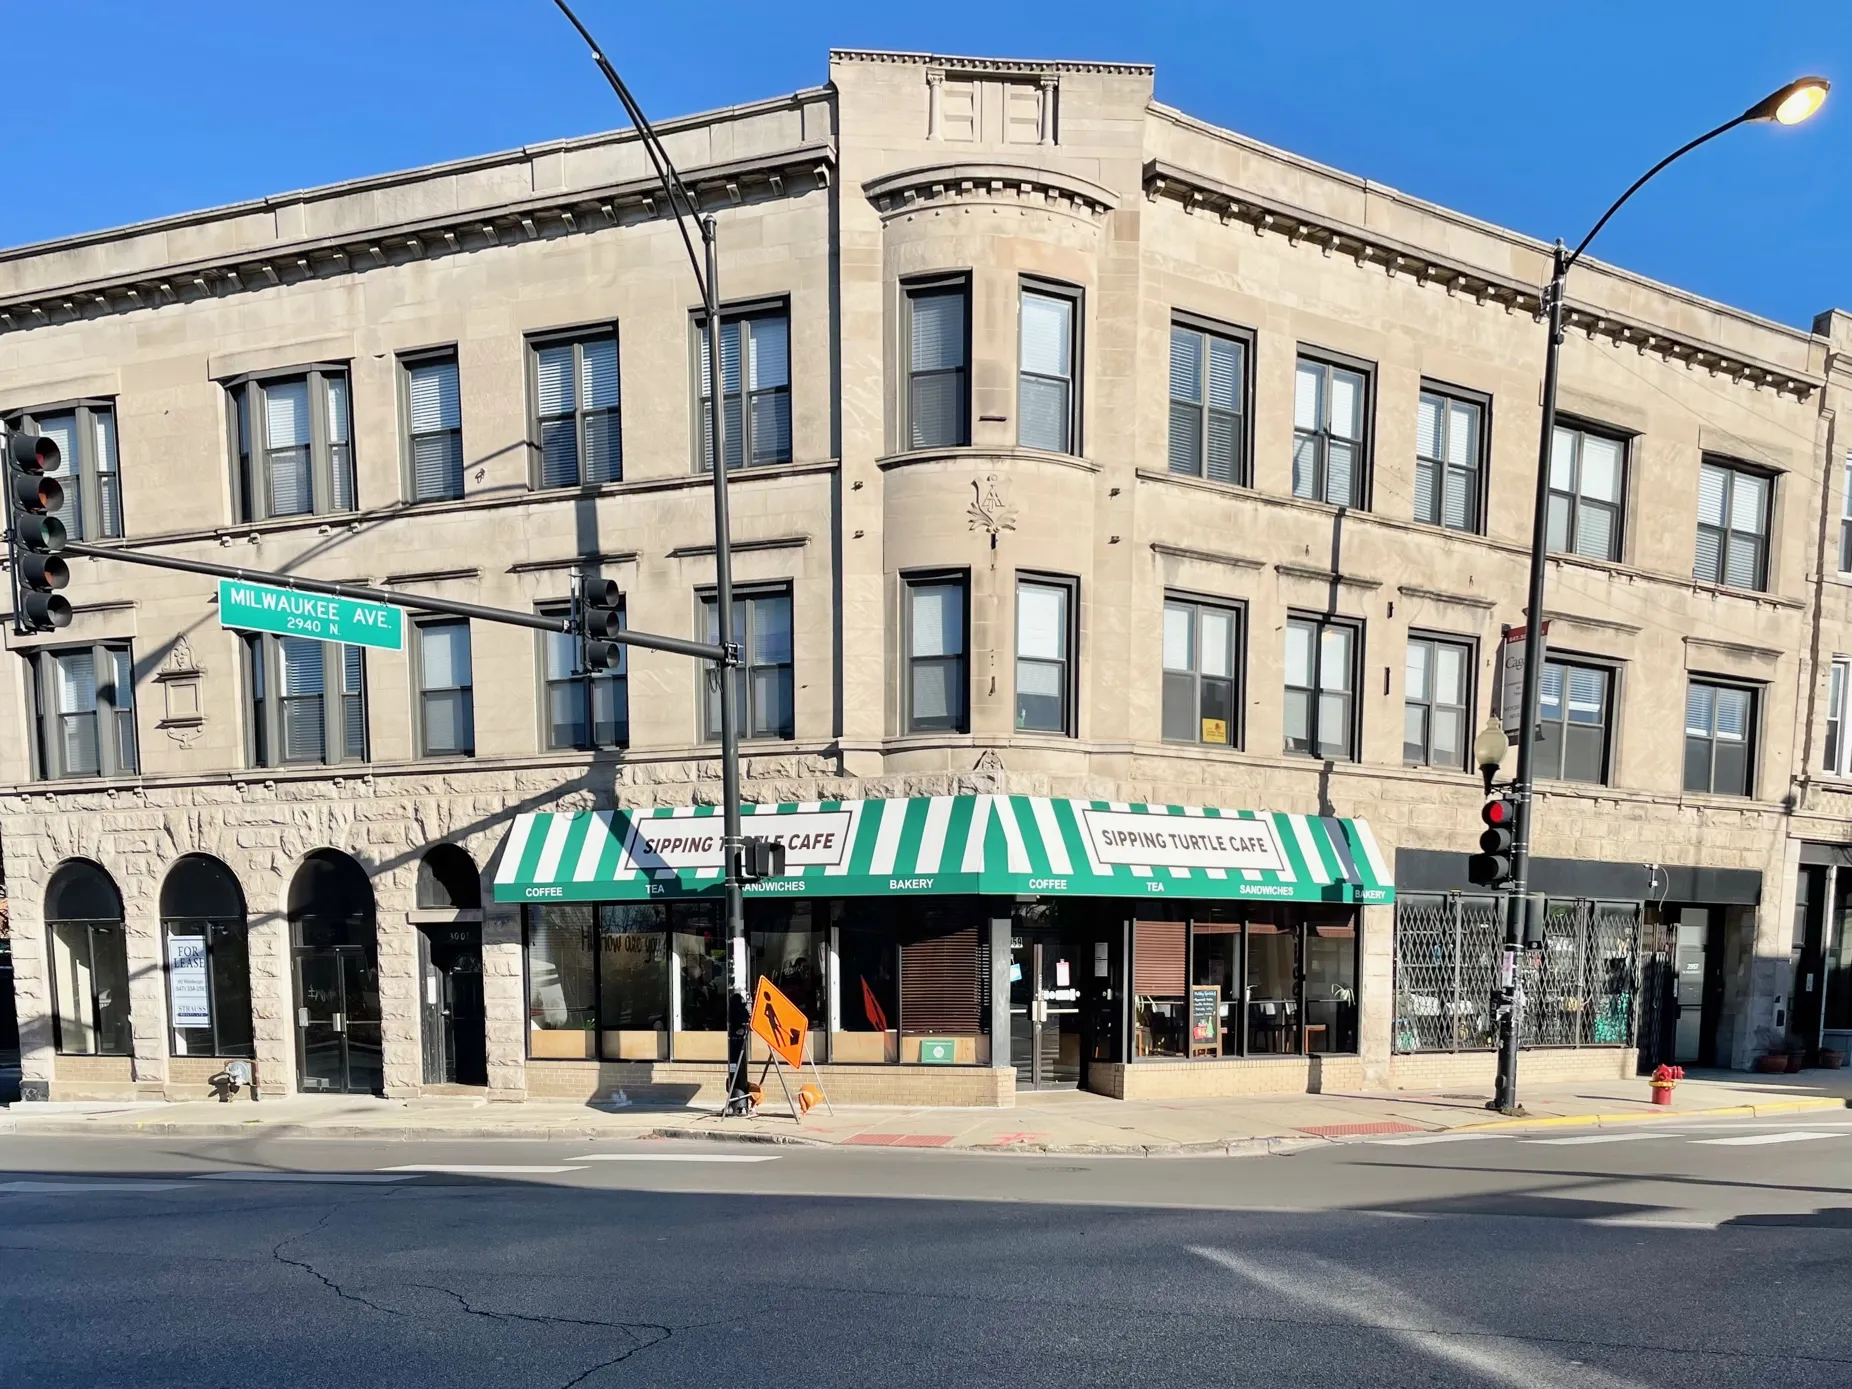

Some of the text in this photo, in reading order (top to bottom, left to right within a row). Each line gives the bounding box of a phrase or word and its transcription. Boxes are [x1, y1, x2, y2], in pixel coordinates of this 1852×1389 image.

[230, 587, 392, 629] MILWAUKEE AVE.
[287, 616, 341, 636] 2940 N.
[1505, 656, 1525, 670] Cag
[643, 833, 836, 854] SIPPING TTE CAFE
[1101, 829, 1269, 853] SIPPING TURTLE CAFE
[645, 884, 665, 895] TEA
[742, 881, 806, 892] ANDWICHES
[889, 878, 934, 890] BAKERY
[1029, 879, 1068, 890] COFFEE
[1146, 881, 1165, 892] TEA
[1239, 884, 1295, 896] SANDWICHES
[525, 886, 563, 898] COFFEE
[1354, 889, 1387, 899] BAKERY
[178, 946, 200, 957] FOR
[174, 957, 206, 969] LEASE
